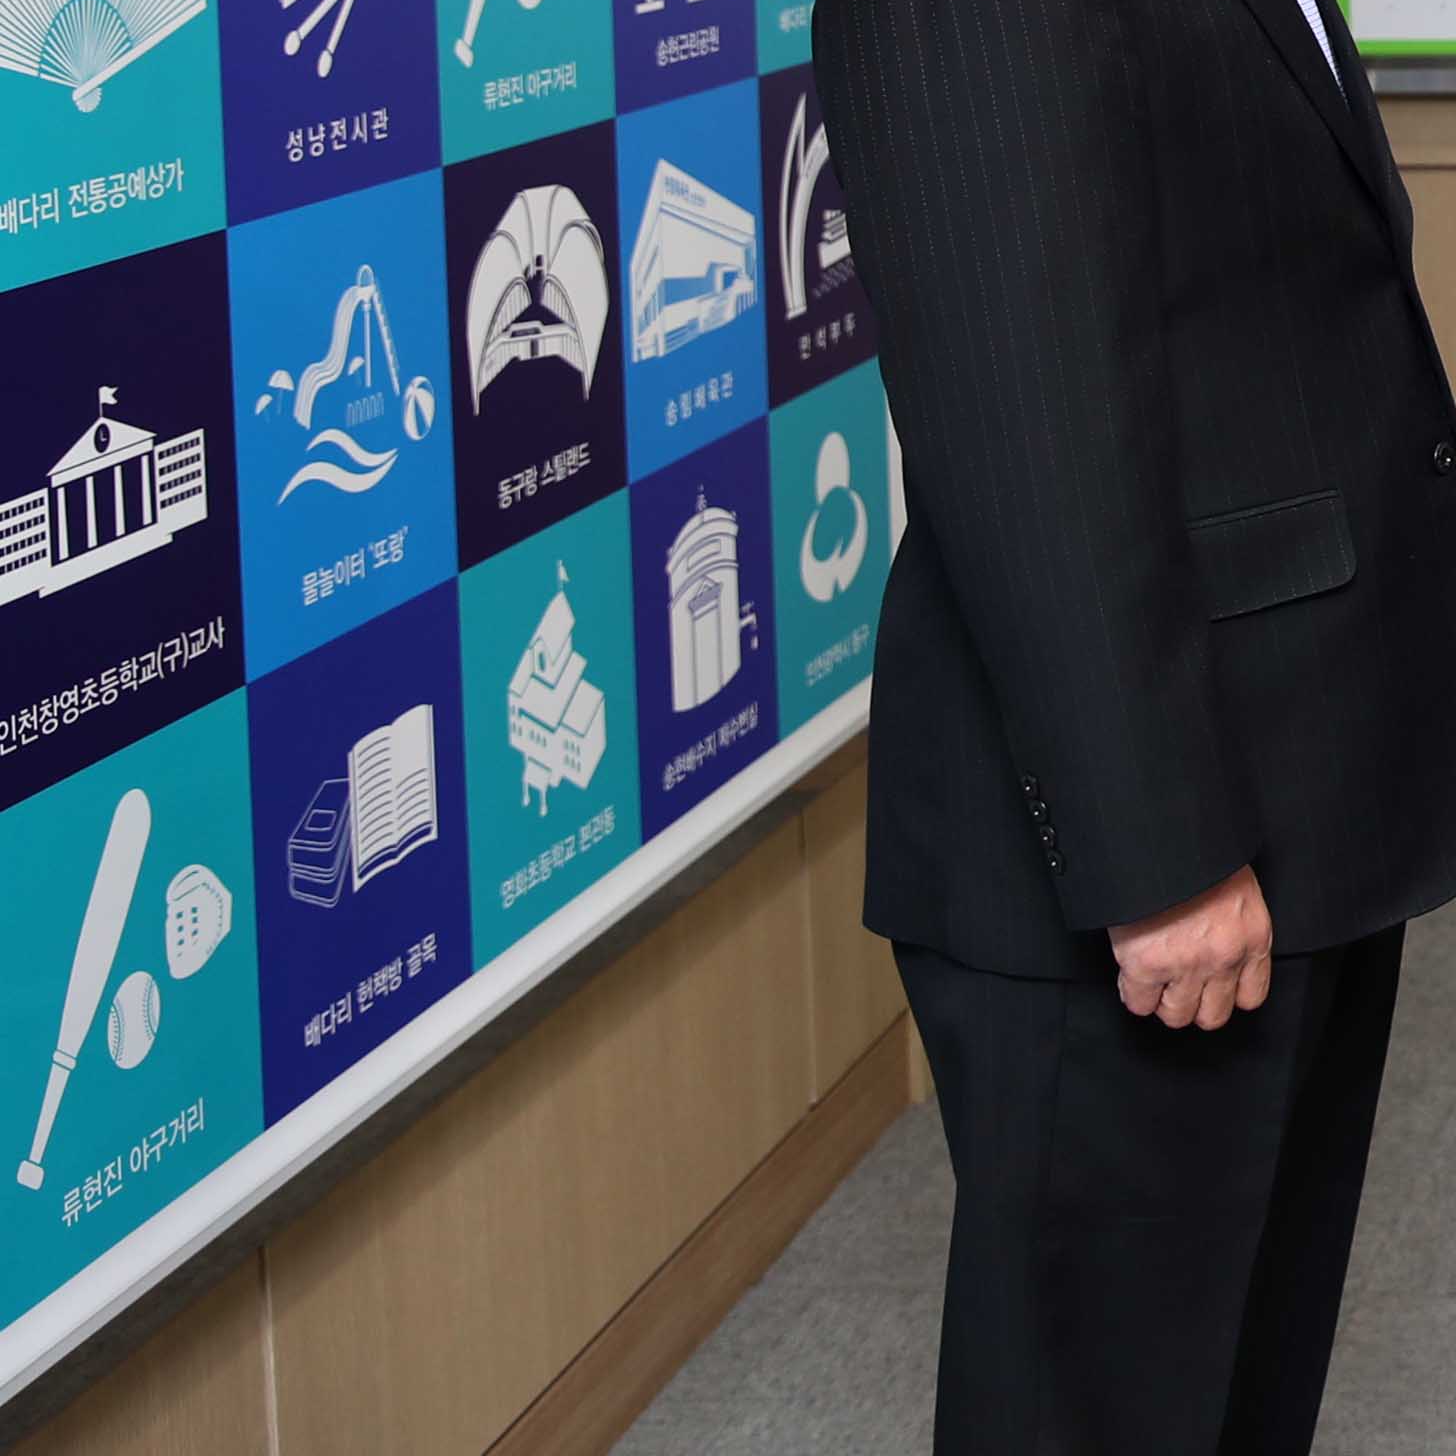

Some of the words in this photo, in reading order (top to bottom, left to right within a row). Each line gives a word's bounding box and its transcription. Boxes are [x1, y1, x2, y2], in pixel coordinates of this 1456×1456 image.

[482, 73, 526, 112] 류현진
[527, 60, 579, 97] 야구거리
[285, 106, 391, 164] 성냥전시관
[0, 186, 60, 236] 배다리
[68, 156, 186, 221] 전통공예상가
[496, 462, 540, 511] 동구랑
[540, 441, 593, 488] 스틸랜드
[300, 552, 367, 608] 물놀이터
[0, 614, 227, 758] 인천창영초등학교(구)교사
[303, 989, 354, 1049] 배다리
[356, 959, 403, 1016] 헌책방
[406, 932, 437, 979] 골목
[60, 1154, 125, 1228] 류현진
[129, 1096, 206, 1174] 야구거리
